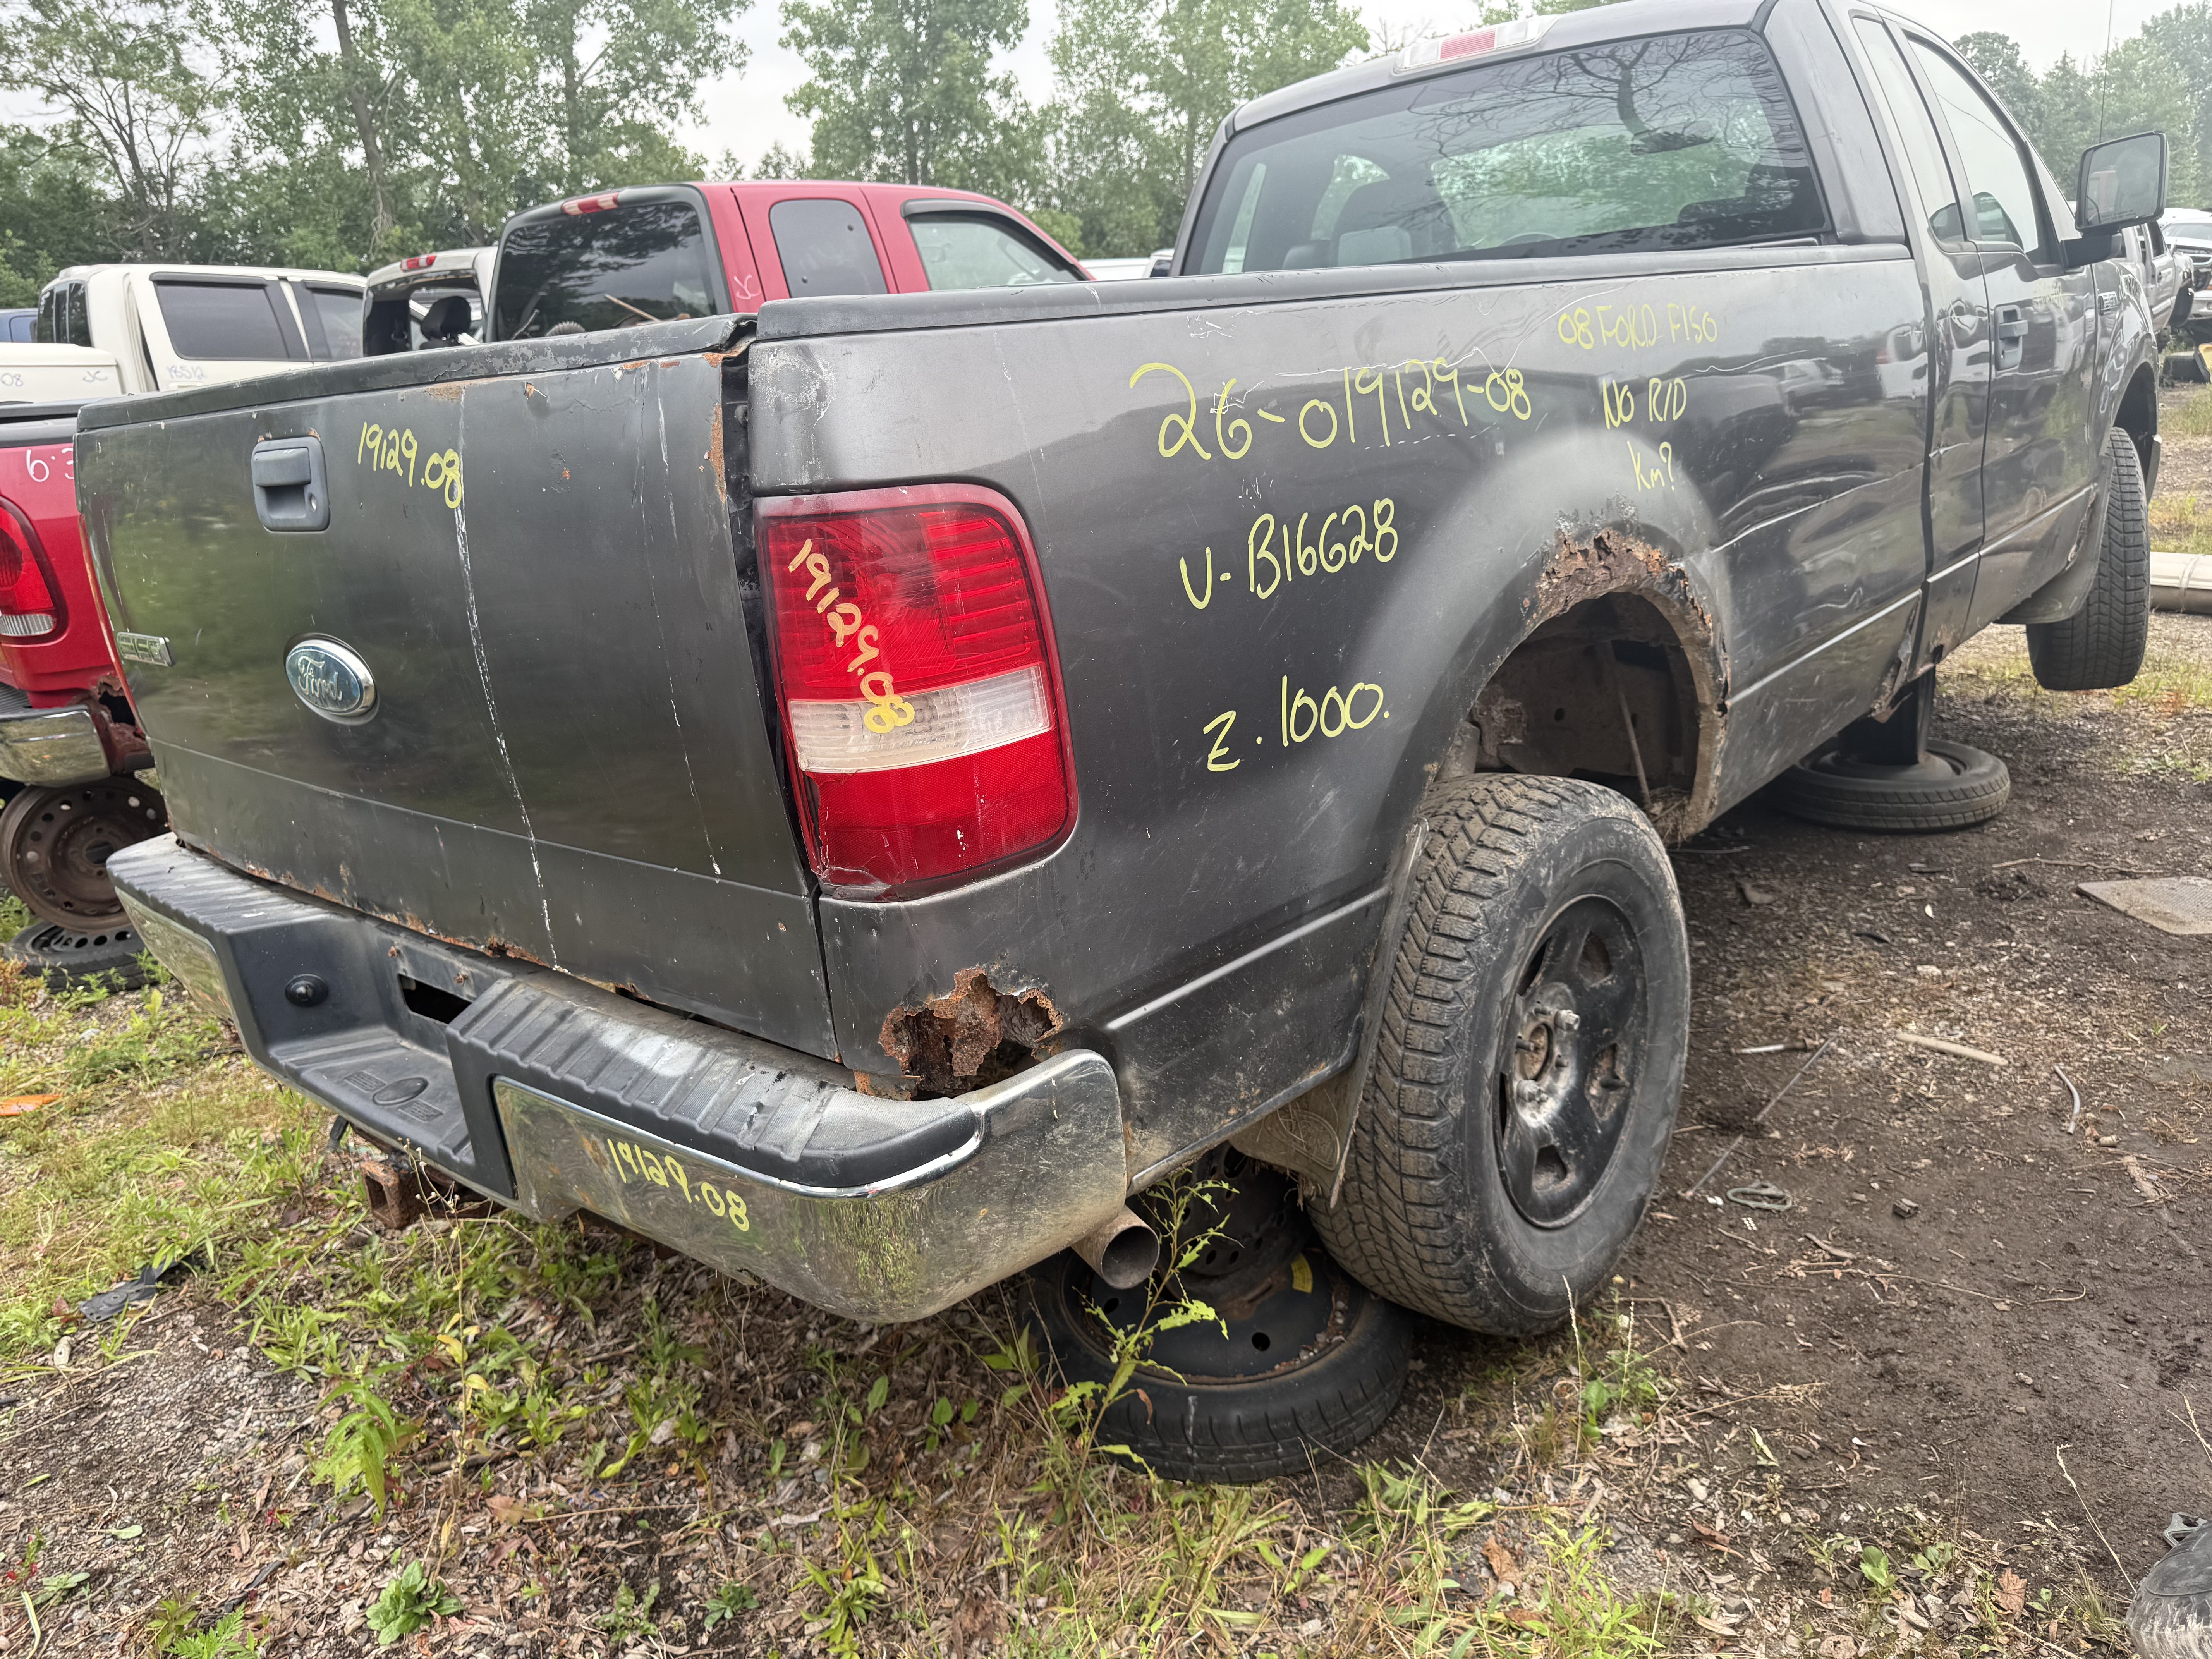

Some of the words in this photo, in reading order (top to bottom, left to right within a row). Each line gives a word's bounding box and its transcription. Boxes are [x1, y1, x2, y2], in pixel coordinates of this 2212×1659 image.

[1558, 307, 1594, 349] 08
[1596, 304, 1657, 351] FORD
[1, 373, 23, 387] 08
[1602, 378, 1634, 430] NO
[297, 656, 342, 701] Ford
